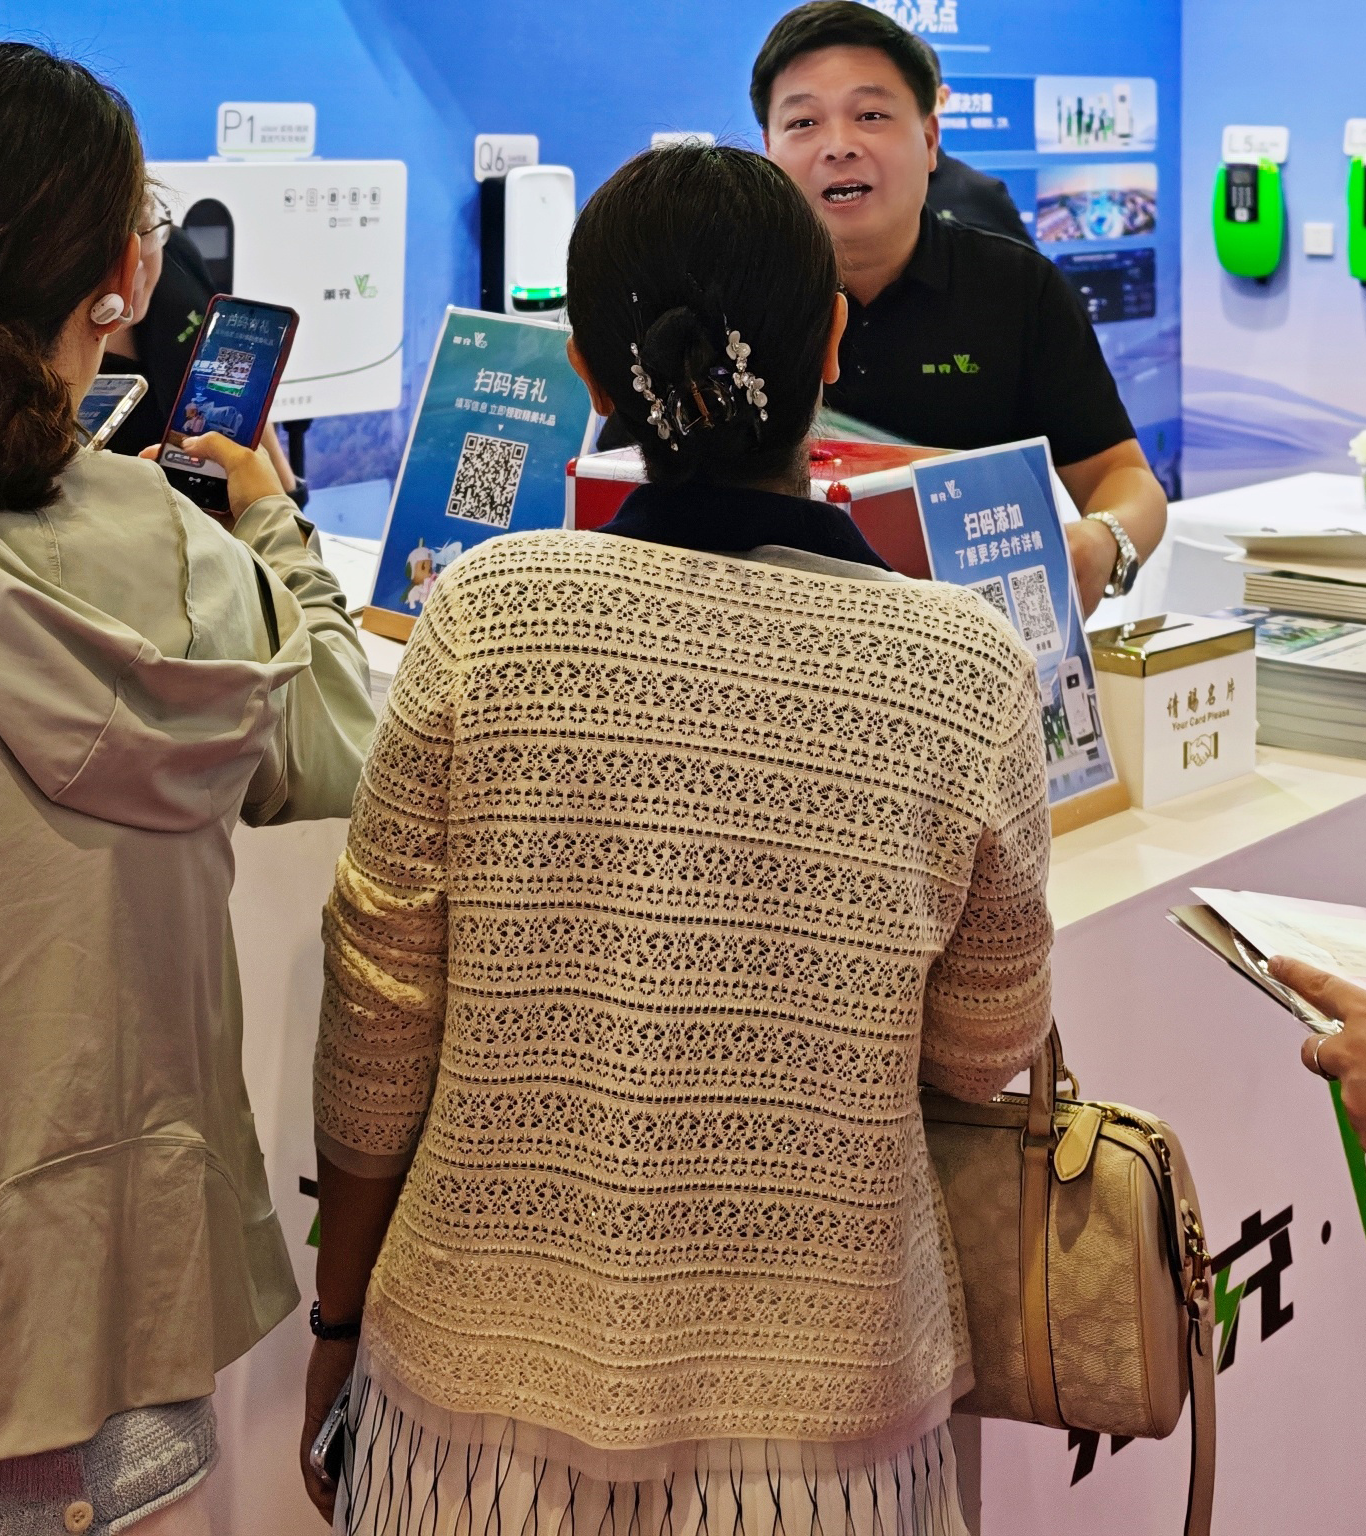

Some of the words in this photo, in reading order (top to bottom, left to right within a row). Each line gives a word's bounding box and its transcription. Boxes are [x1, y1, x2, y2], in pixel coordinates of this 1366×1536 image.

[223, 109, 254, 144] P1
[478, 141, 505, 173] Q6
[473, 367, 548, 403] 扫码有礼
[963, 503, 1025, 541] 扫码添加
[955, 530, 1044, 570] 了解更多合作详情
[1171, 719, 1188, 733] Your
[1188, 715, 1207, 729] Card
[1207, 707, 1231, 724] Please
